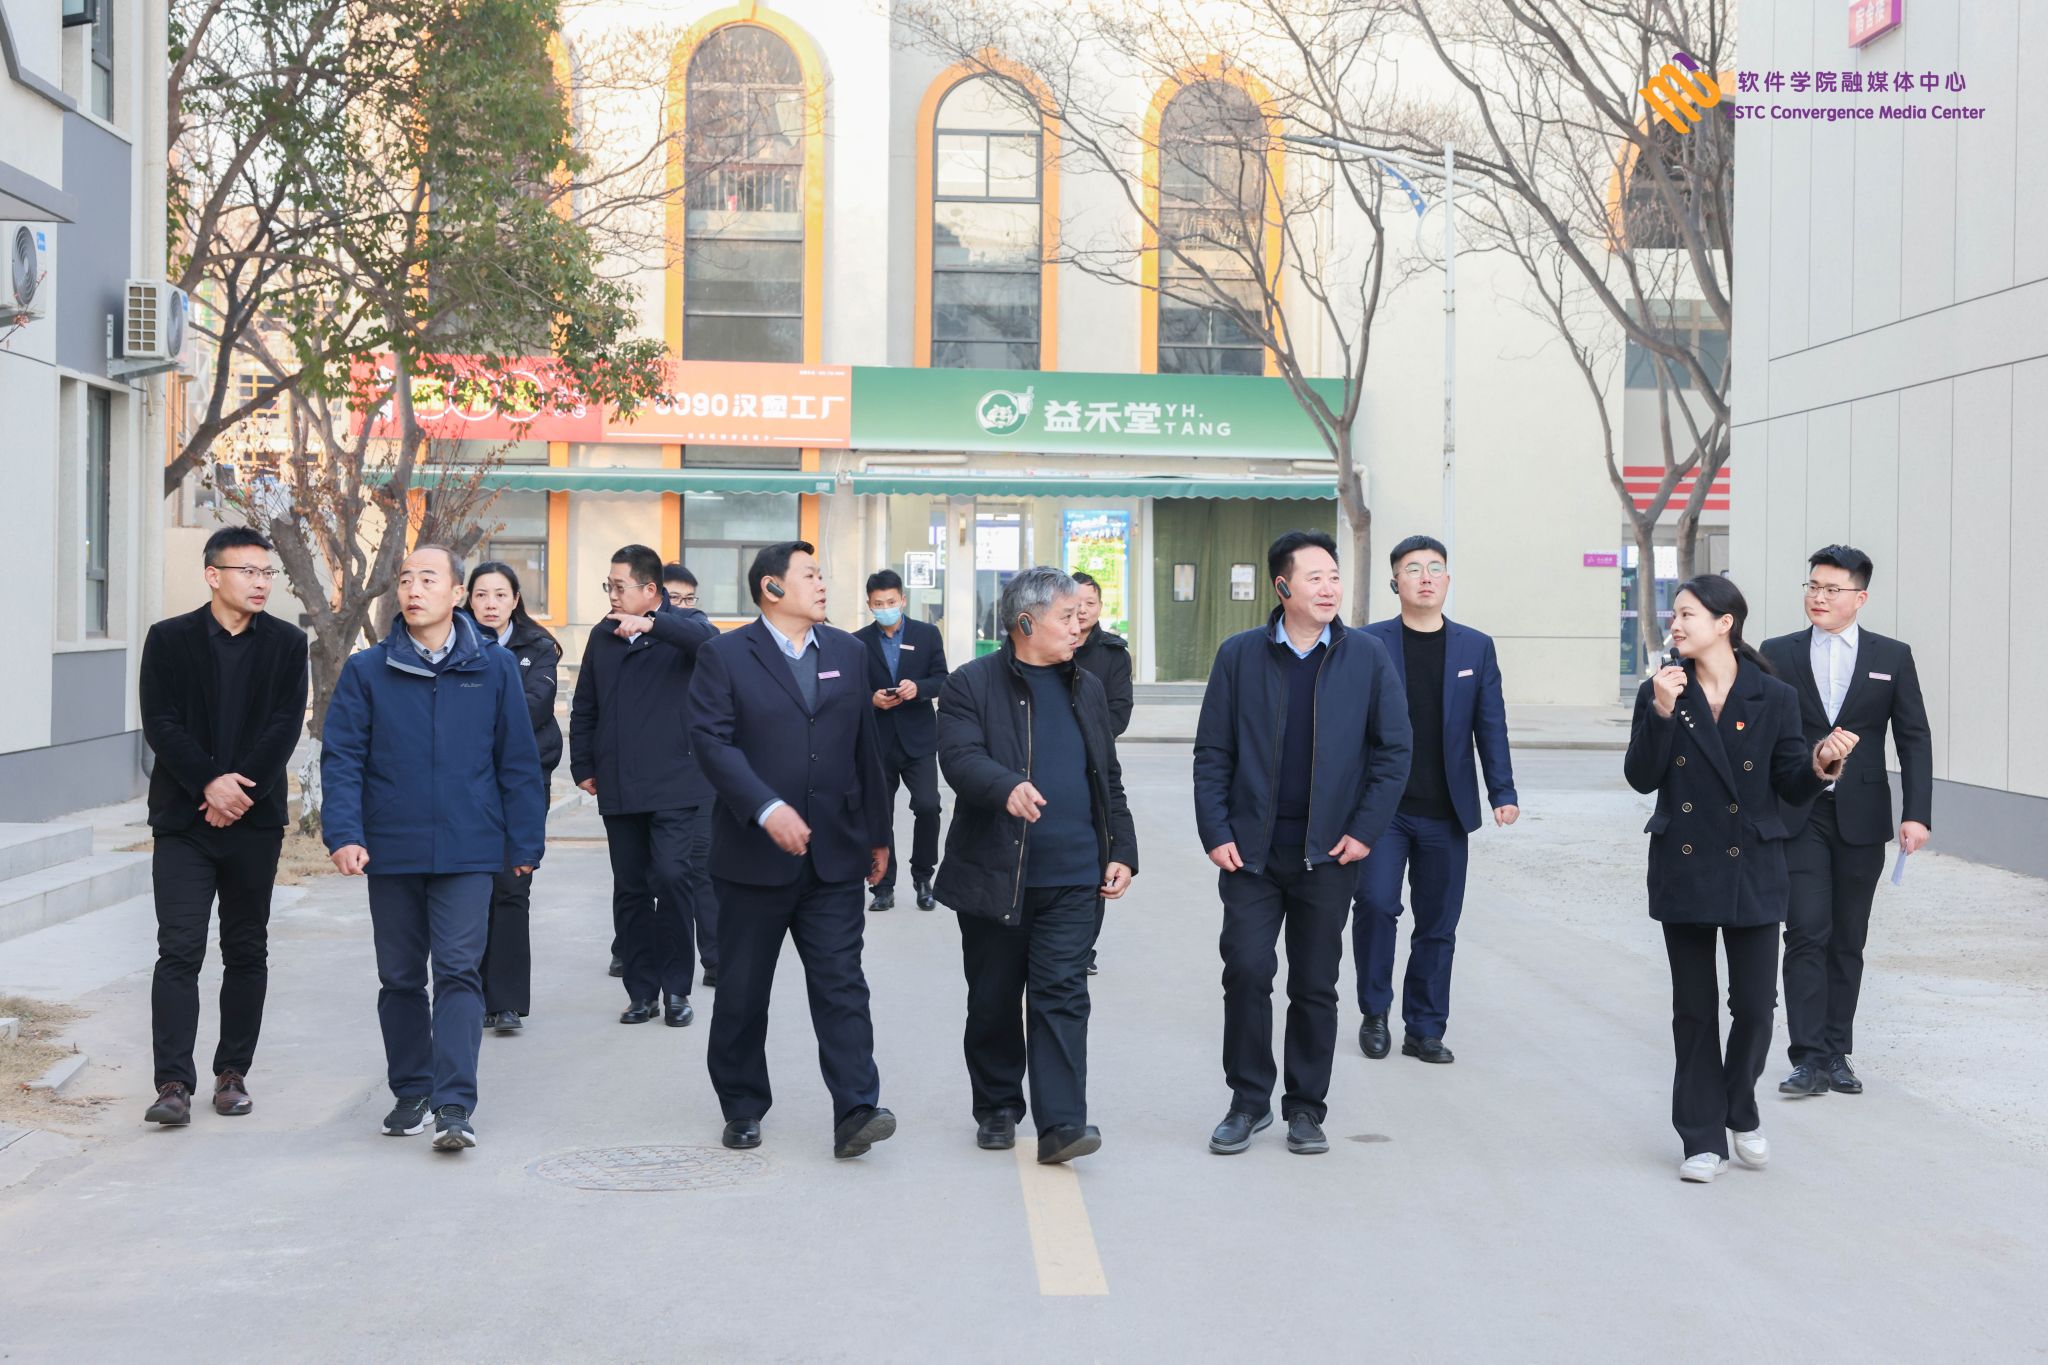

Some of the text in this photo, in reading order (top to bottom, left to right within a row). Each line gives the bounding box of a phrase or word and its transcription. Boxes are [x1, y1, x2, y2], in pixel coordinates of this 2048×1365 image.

[1044, 401, 1161, 433] 益禾堂
[1165, 404, 1204, 417] YH.
[1164, 422, 1231, 436] TANG
